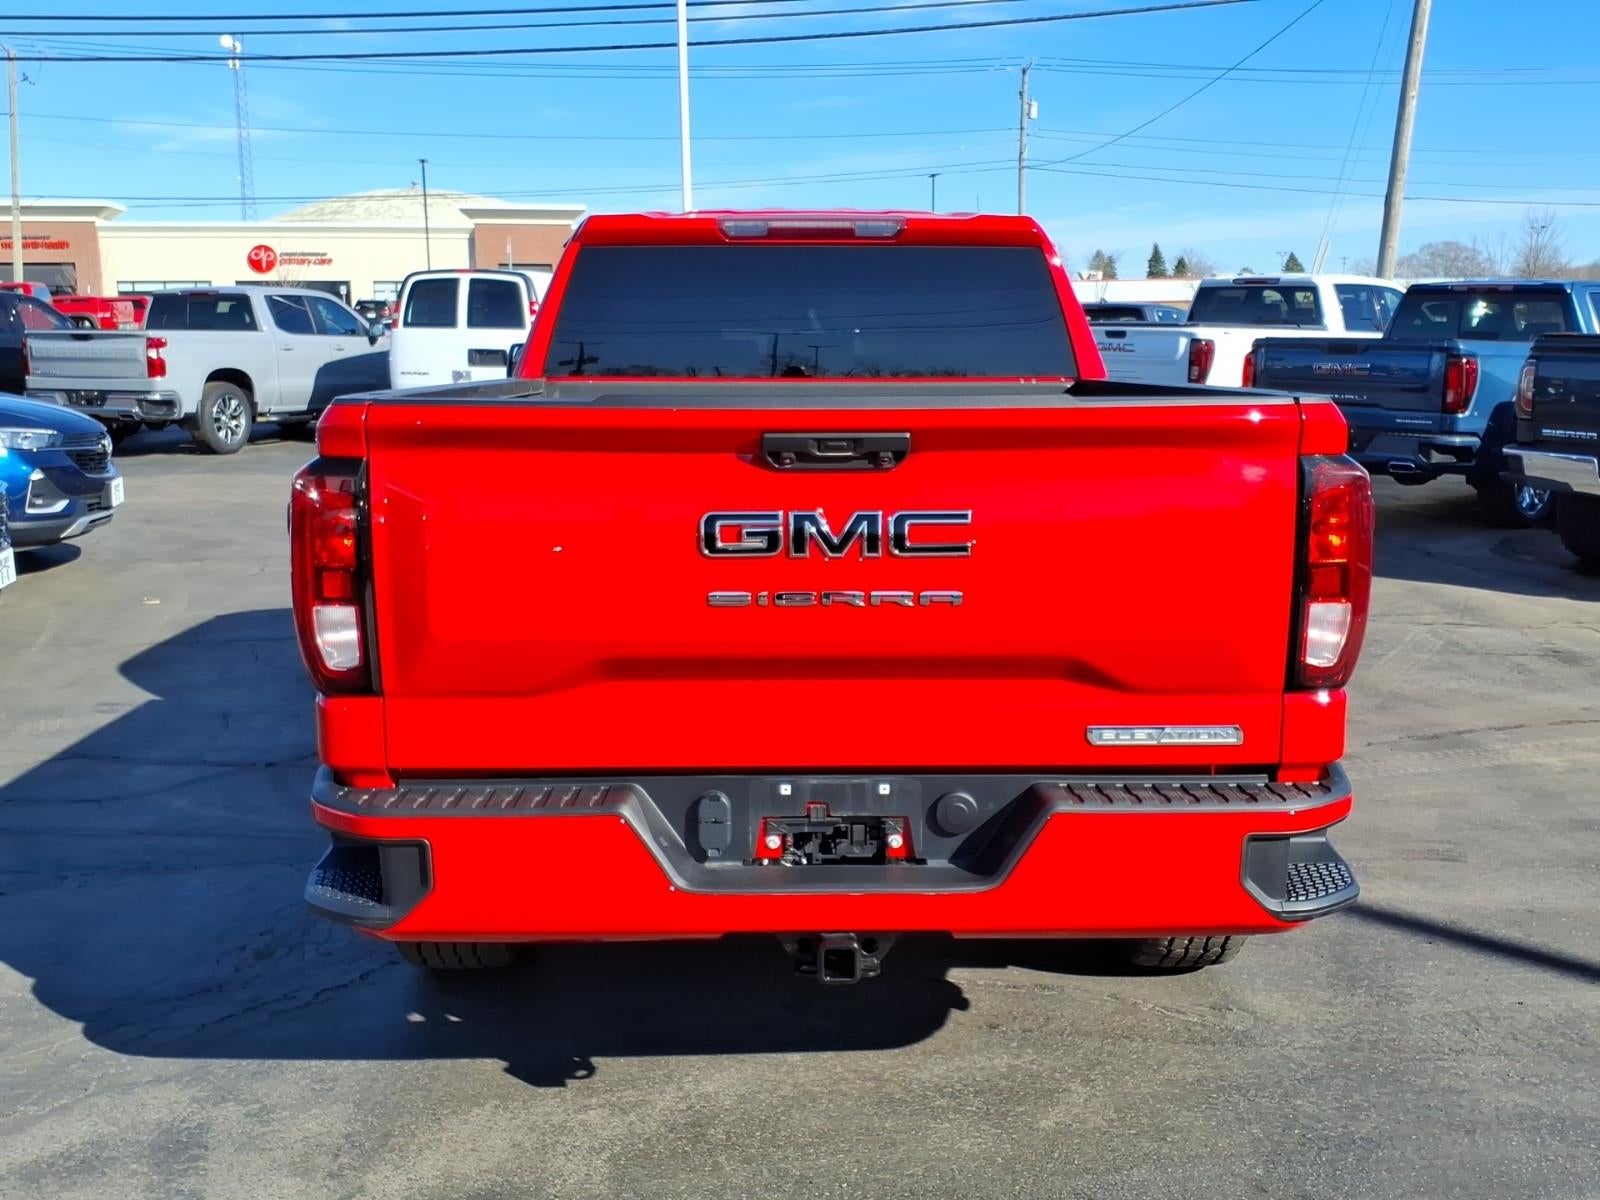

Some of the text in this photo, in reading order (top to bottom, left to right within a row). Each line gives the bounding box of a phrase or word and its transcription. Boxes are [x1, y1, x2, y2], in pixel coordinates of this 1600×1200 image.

[1313, 362, 1371, 375] GMC
[700, 509, 973, 558] GMC
[707, 590, 964, 607] SIERRA
[1098, 727, 1233, 741] ELEVATION
